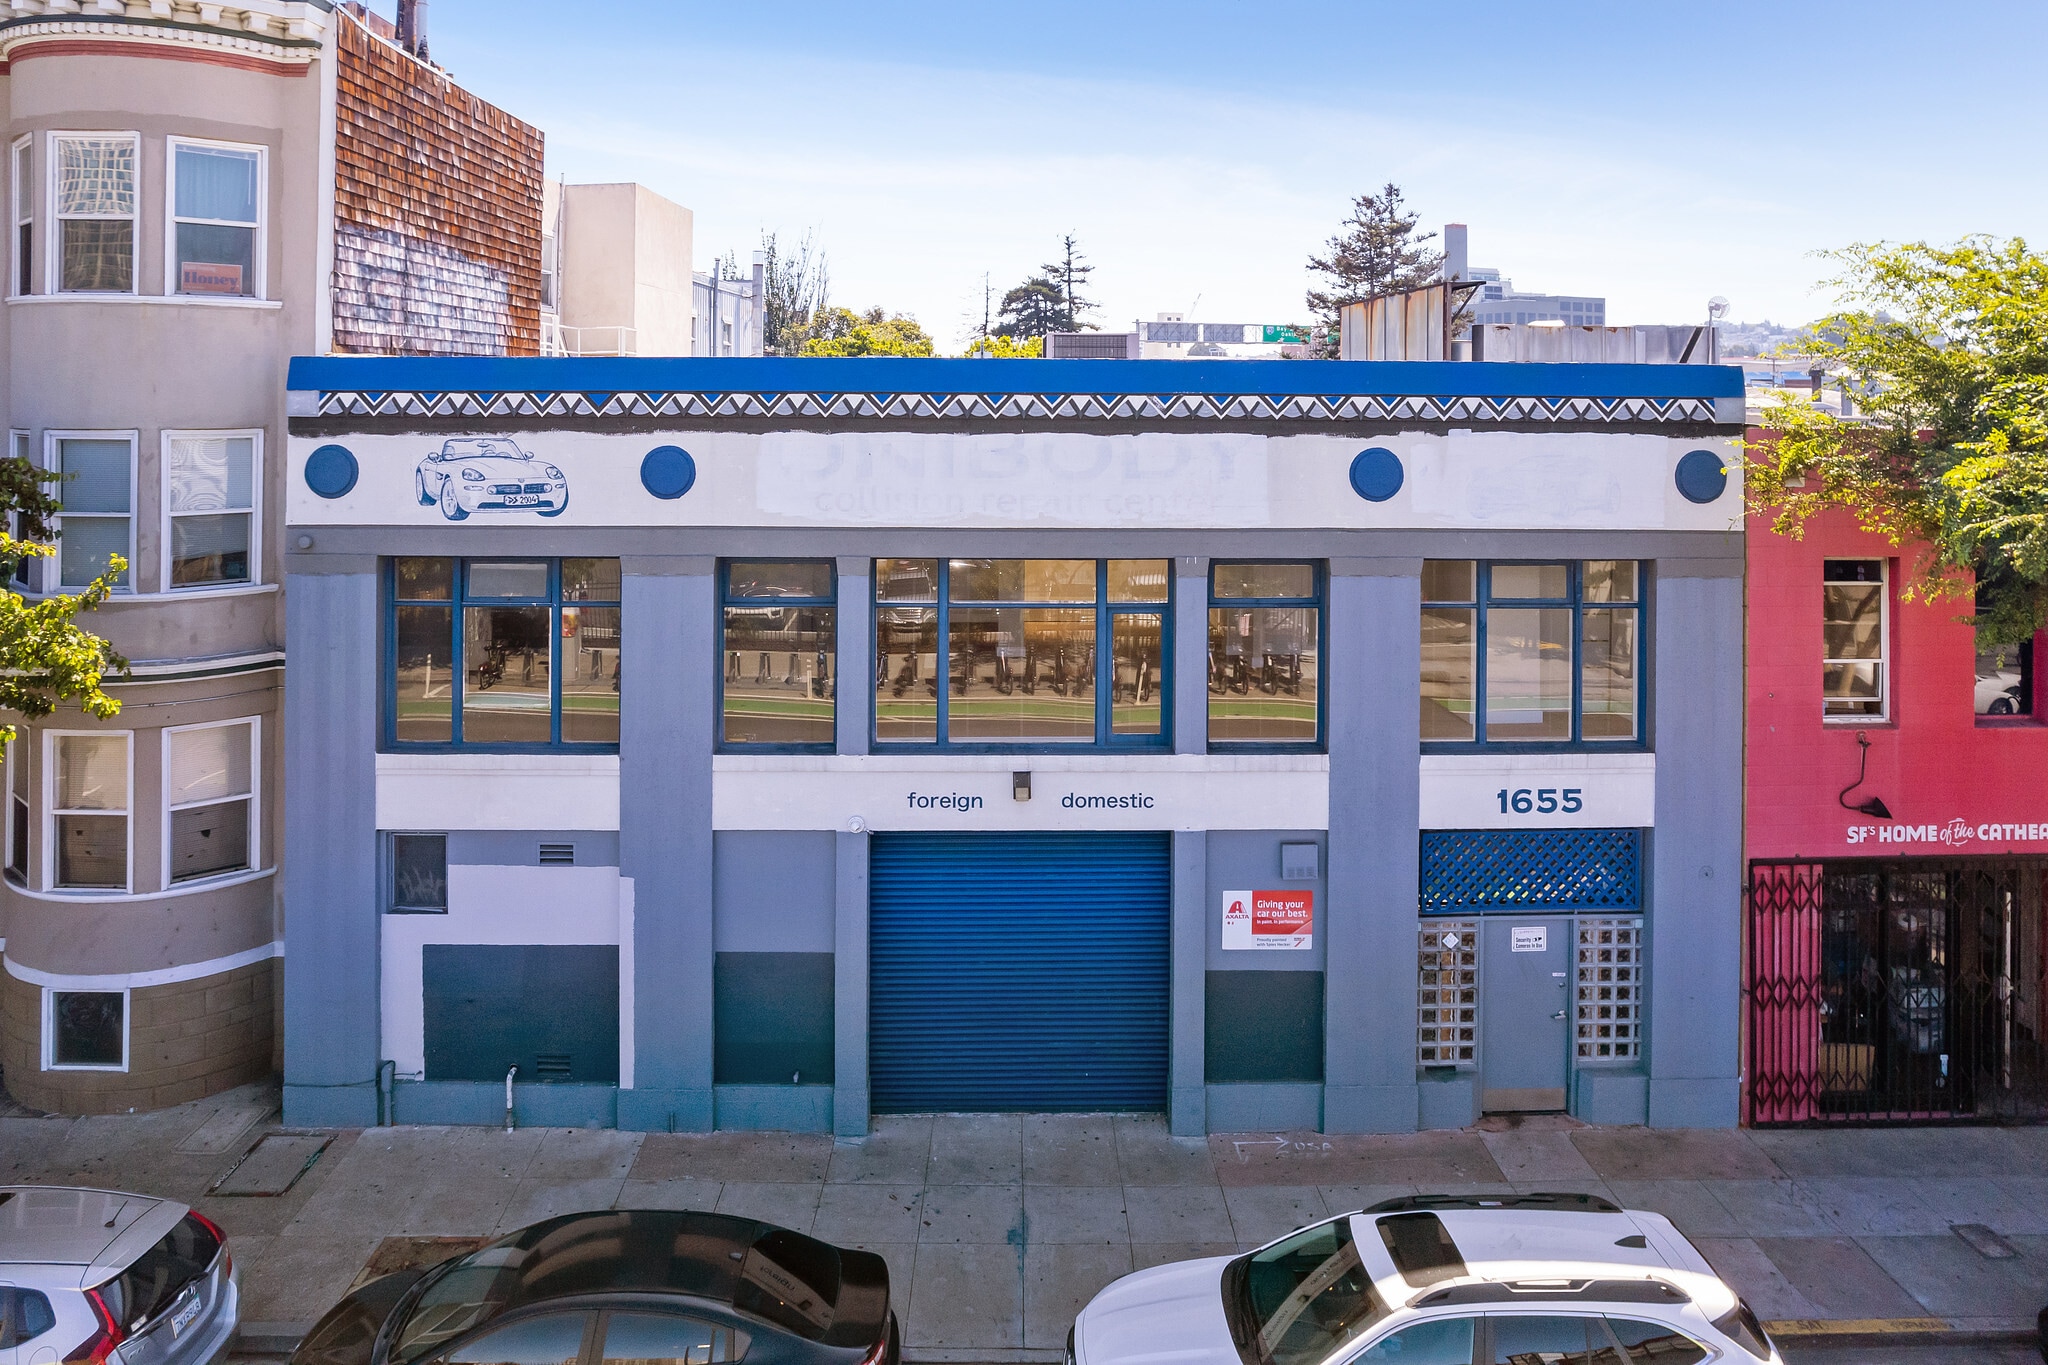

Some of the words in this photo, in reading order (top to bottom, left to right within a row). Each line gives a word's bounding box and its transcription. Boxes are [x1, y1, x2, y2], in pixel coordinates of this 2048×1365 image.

[907, 792, 983, 812] foreign
[1061, 792, 1154, 809] domestic
[1497, 788, 1583, 814] 1655
[1879, 825, 1938, 843] HOME
[1939, 827, 1953, 846] of
[1953, 823, 1975, 839] the
[1977, 823, 2048, 840] CATHEA
[1257, 900, 1283, 910] Giving
[1287, 910, 1308, 918] best.
